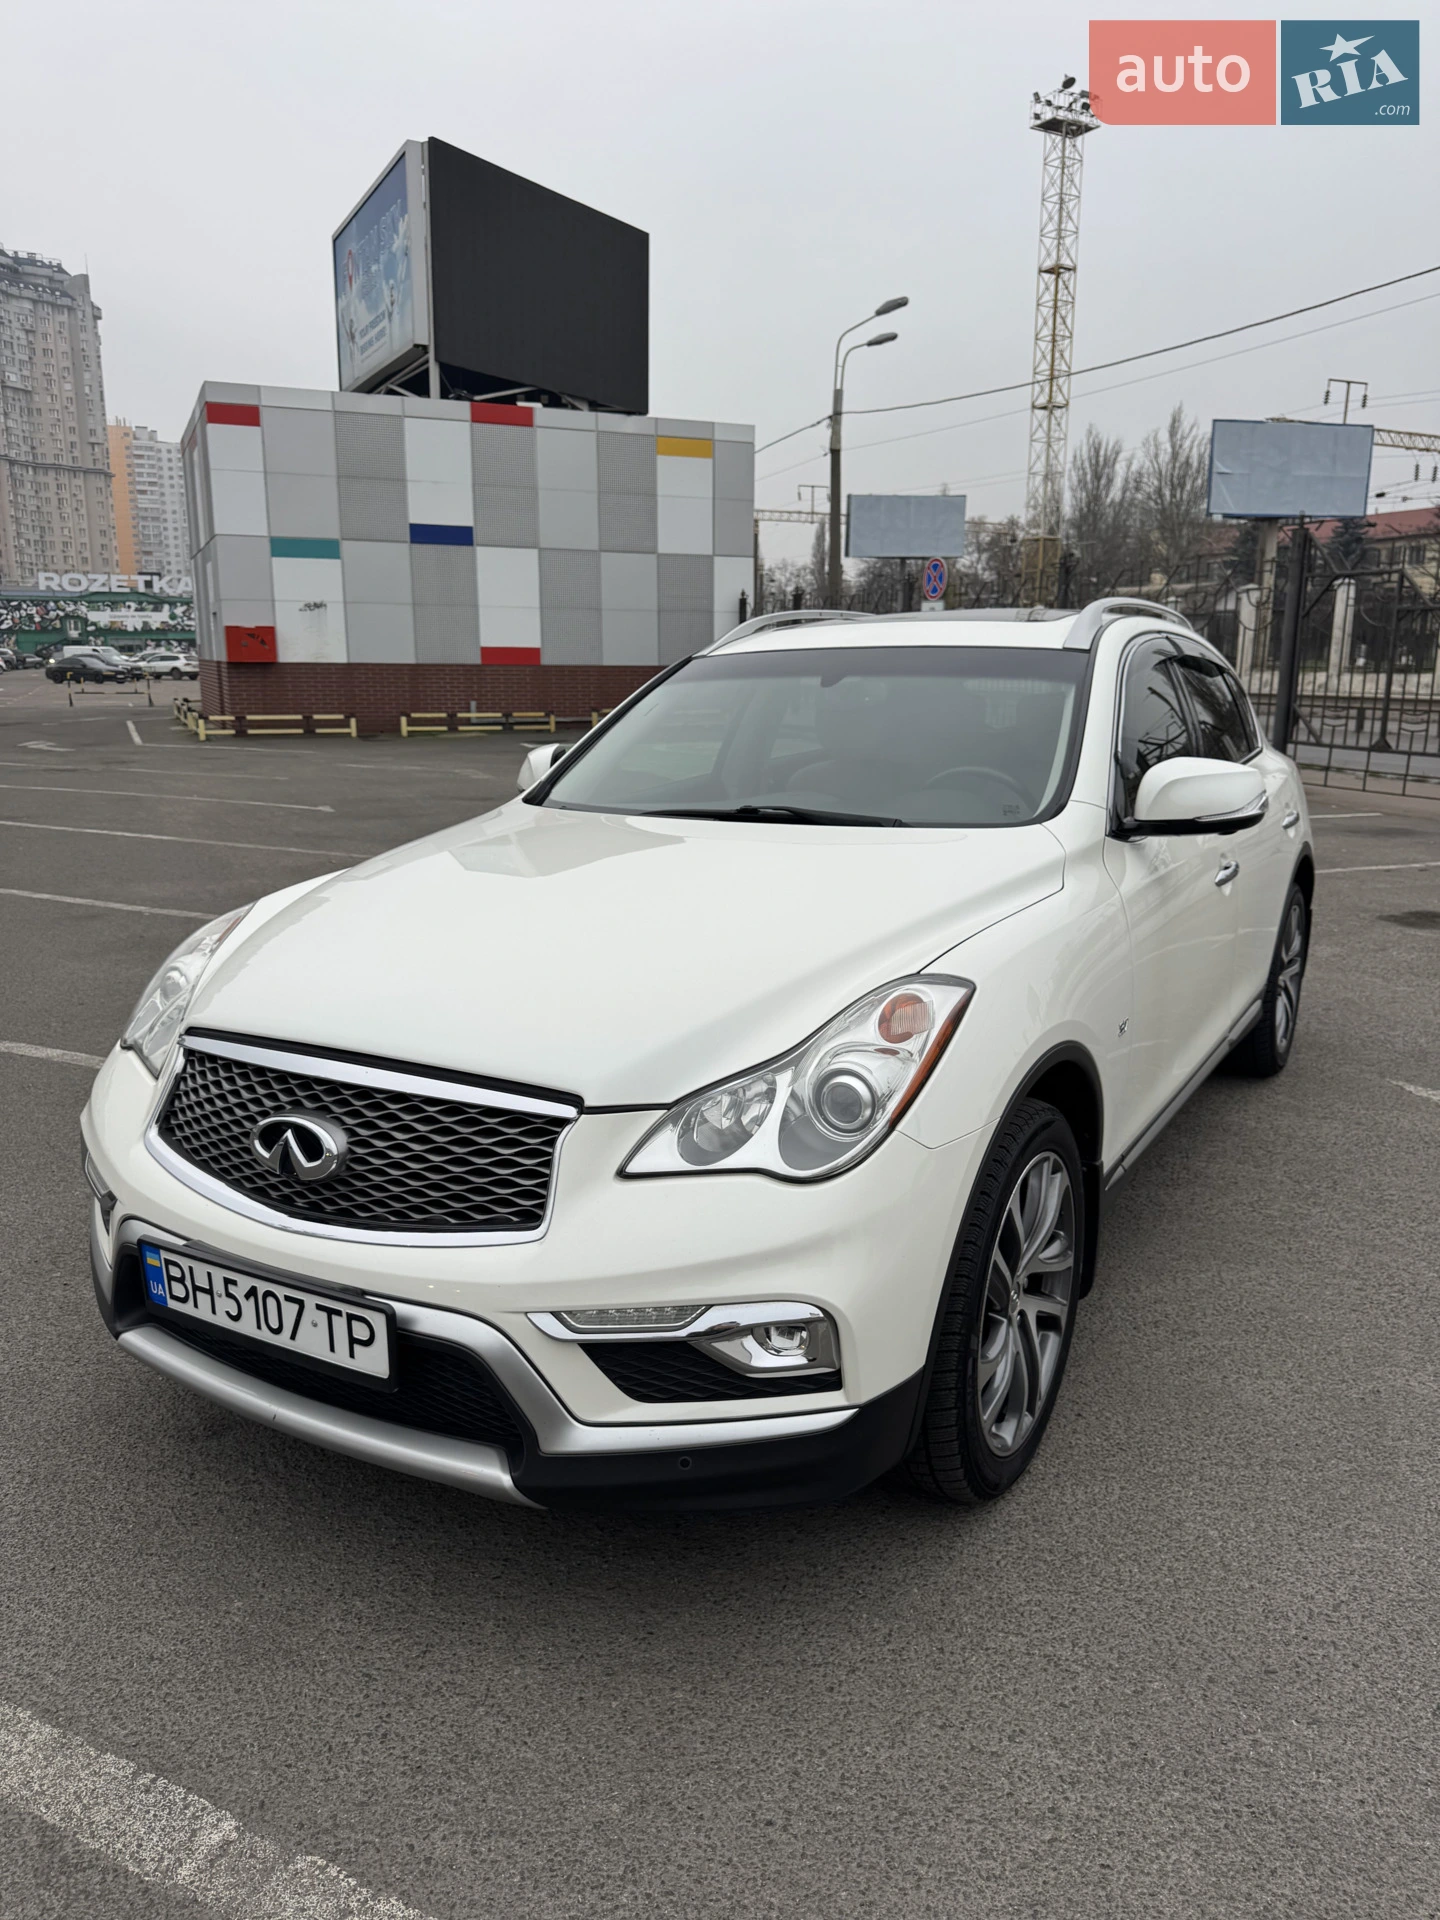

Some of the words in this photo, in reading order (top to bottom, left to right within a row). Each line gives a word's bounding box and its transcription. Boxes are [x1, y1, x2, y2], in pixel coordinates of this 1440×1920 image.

[38, 571, 193, 594] ROZETKA
[150, 1280, 165, 1298] UA
[163, 1257, 217, 1316] BH
[223, 1276, 306, 1342] 5107
[315, 1302, 376, 1360] TP
